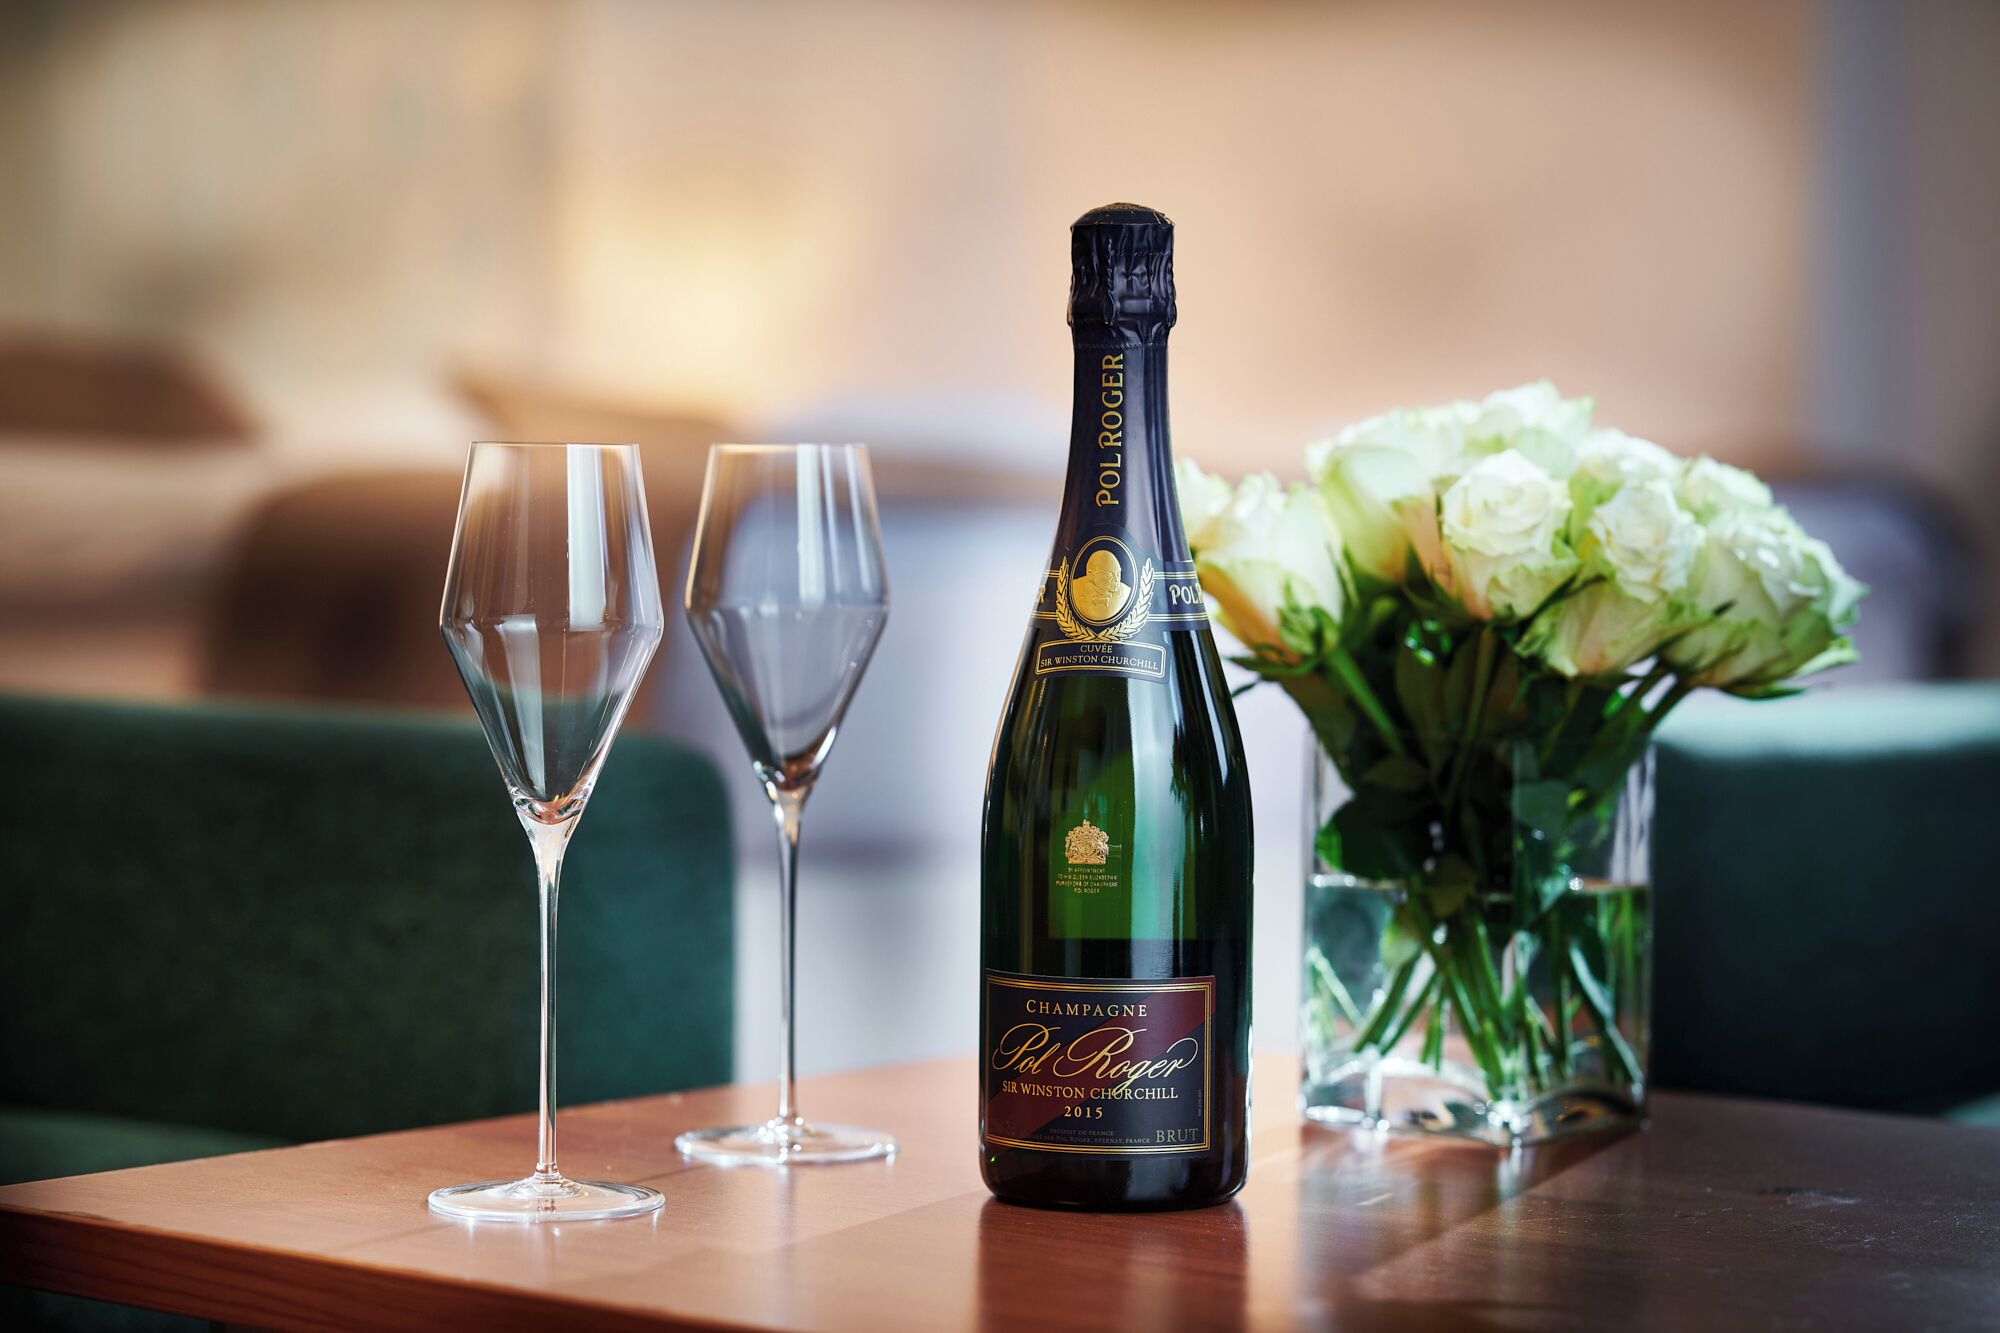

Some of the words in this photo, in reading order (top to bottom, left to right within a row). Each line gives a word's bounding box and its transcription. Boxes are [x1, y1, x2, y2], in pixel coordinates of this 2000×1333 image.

[1098, 353, 1124, 449] ROGER
[1096, 452, 1121, 507] POL
[1080, 643, 1113, 653] CUVÉE
[1040, 657, 1053, 667] SIR
[1054, 655, 1098, 665] WINSTON
[1100, 655, 1159, 670] CHURCHILL
[1026, 999, 1147, 1017] CHAMPAGNE
[992, 1023, 1061, 1075] Pol
[1053, 1027, 1199, 1097] Roger
[1002, 1080, 1018, 1094] SIR
[1019, 1083, 1086, 1099] WINSTON
[1090, 1087, 1179, 1099] CHURCHILL
[1064, 1105, 1104, 1119] 2015
[1155, 1128, 1199, 1143] BRUT
